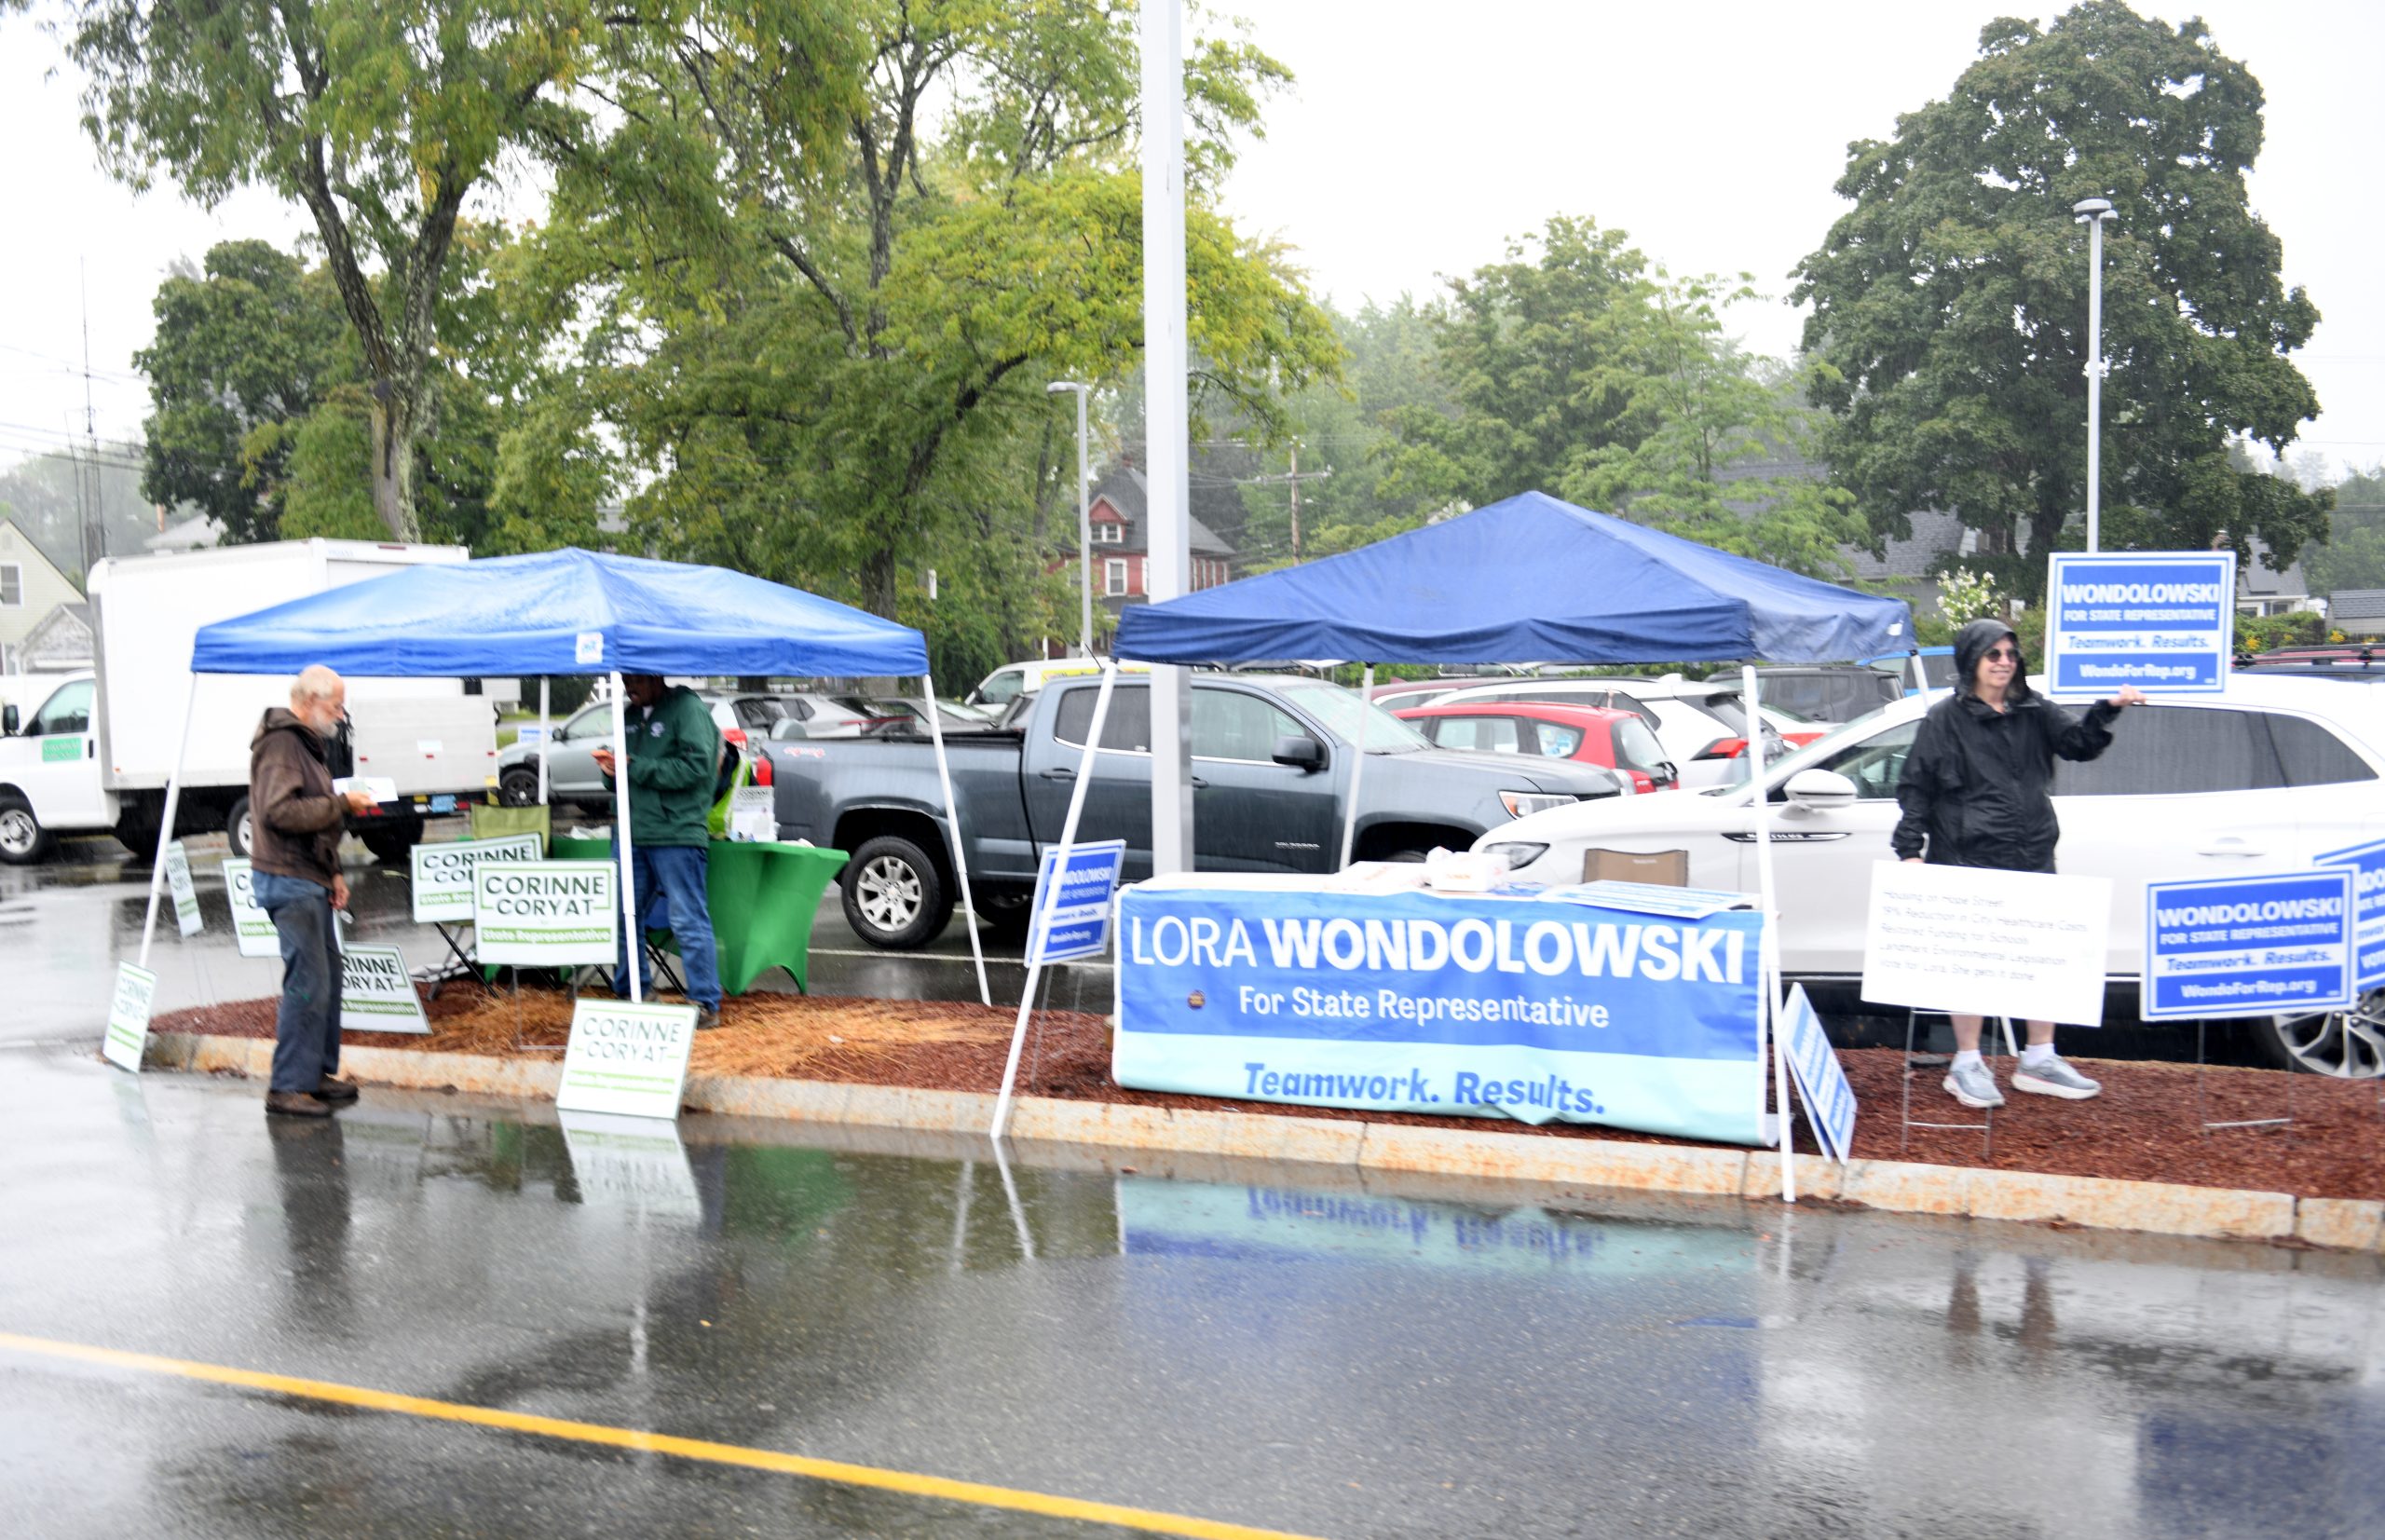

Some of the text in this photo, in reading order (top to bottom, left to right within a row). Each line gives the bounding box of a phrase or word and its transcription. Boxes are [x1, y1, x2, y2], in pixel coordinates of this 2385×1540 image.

[2062, 583, 2219, 604] WONDOLOWSKI
[2064, 608, 2216, 621] FOR STATE REPRESENTATIVE
[2068, 634, 2209, 649] Teamwork. Results.
[2079, 663, 2197, 680] WondoForRep.org
[424, 844, 532, 868] CORINNE
[485, 876, 604, 895] CORINNE
[497, 899, 594, 916] CORYAT
[2156, 897, 2342, 928] WONDOLOWSKI
[483, 928, 611, 945] State Representative
[2160, 933, 2187, 945] FOR
[2189, 929, 2228, 944] STATE
[2229, 922, 2338, 940] REPRESENTATIVE
[1132, 915, 1745, 985] LORA WONDOLOWSKI
[2167, 948, 2332, 971] Teamwork. Results.
[343, 954, 399, 975] RINNE
[343, 975, 396, 992] ORYAT
[2180, 979, 2317, 998] WondoForRep.org
[1239, 985, 1285, 1015] For
[1291, 986, 1371, 1019] State
[1378, 988, 1610, 1029] Representative
[583, 1016, 681, 1043] CORINNE
[587, 1041, 668, 1063] CORYAT
[1244, 1062, 1605, 1115] Teamwork. Results.
